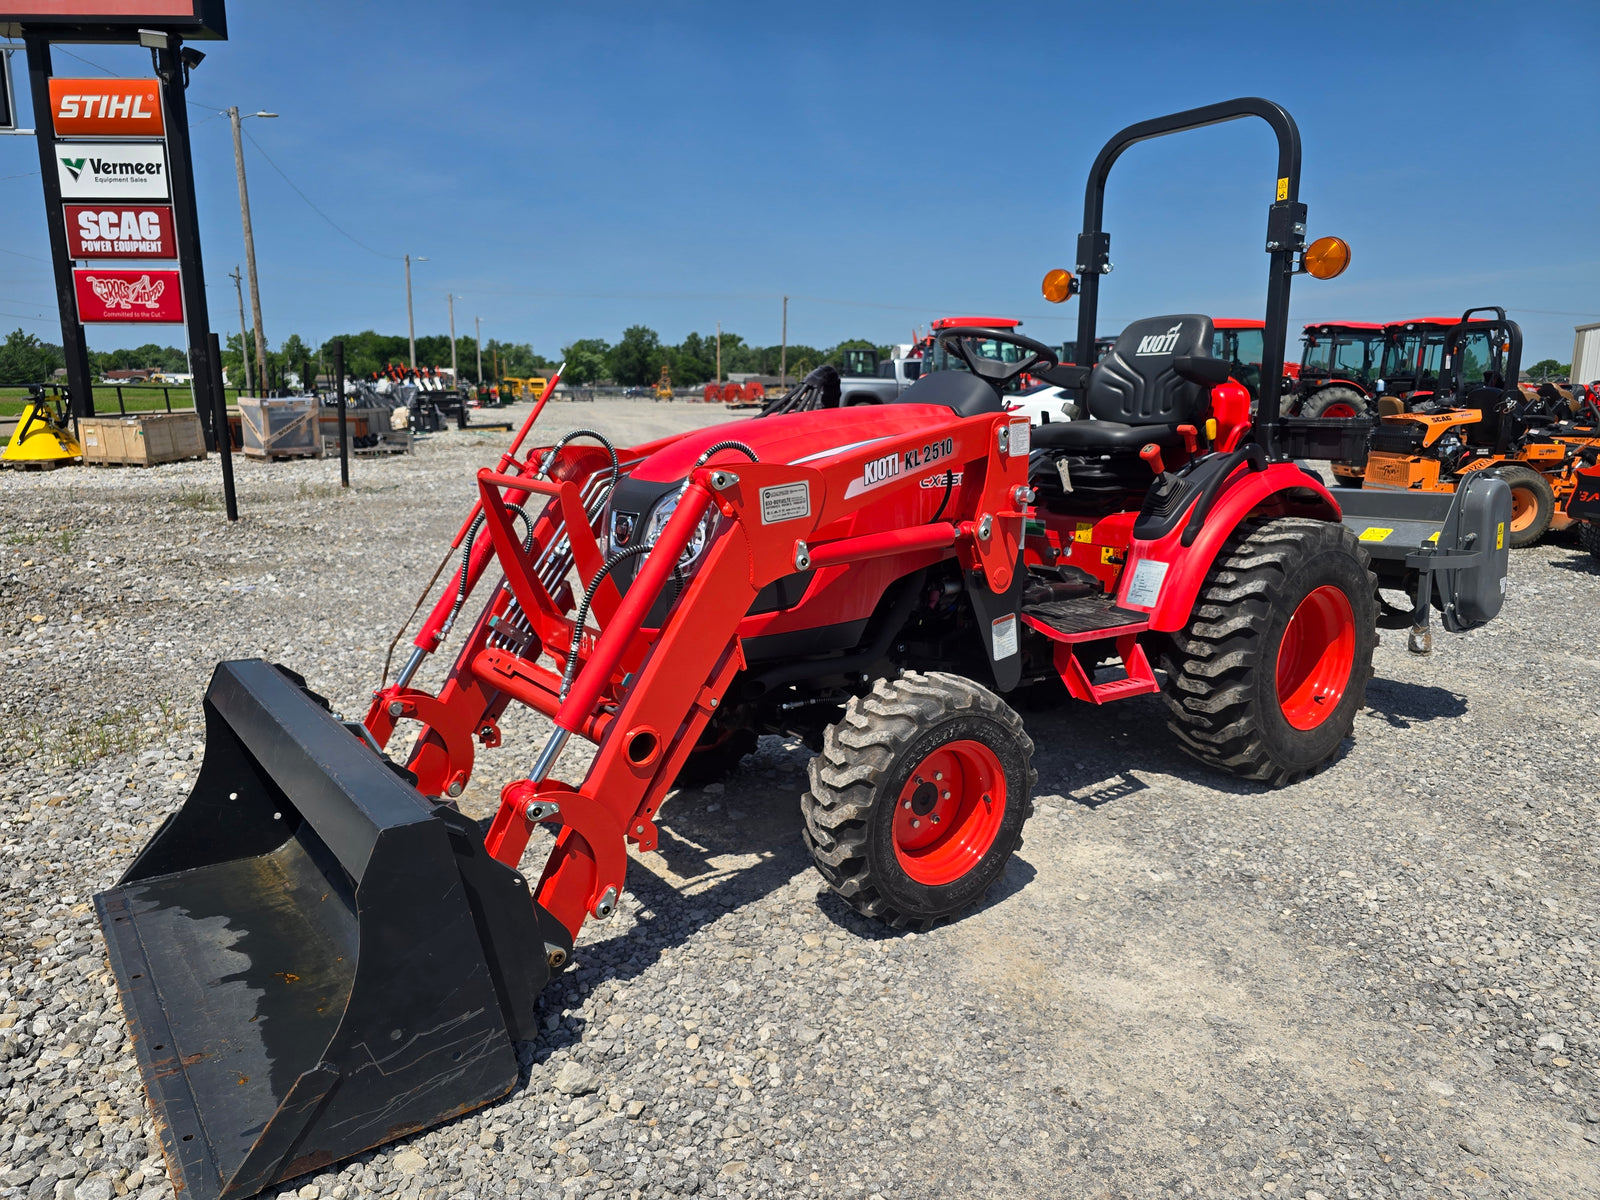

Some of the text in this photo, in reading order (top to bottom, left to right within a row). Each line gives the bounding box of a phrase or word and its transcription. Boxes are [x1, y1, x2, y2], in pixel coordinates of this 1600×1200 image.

[58, 95, 152, 118] STIHL
[89, 158, 162, 175] Vermeer
[78, 211, 161, 240] SCAG
[81, 241, 162, 252] POWER EQUIPMENT
[1137, 333, 1180, 353] KIOTI
[1431, 415, 1452, 423] SCAG
[864, 437, 953, 486] KIOTI KL 2510
